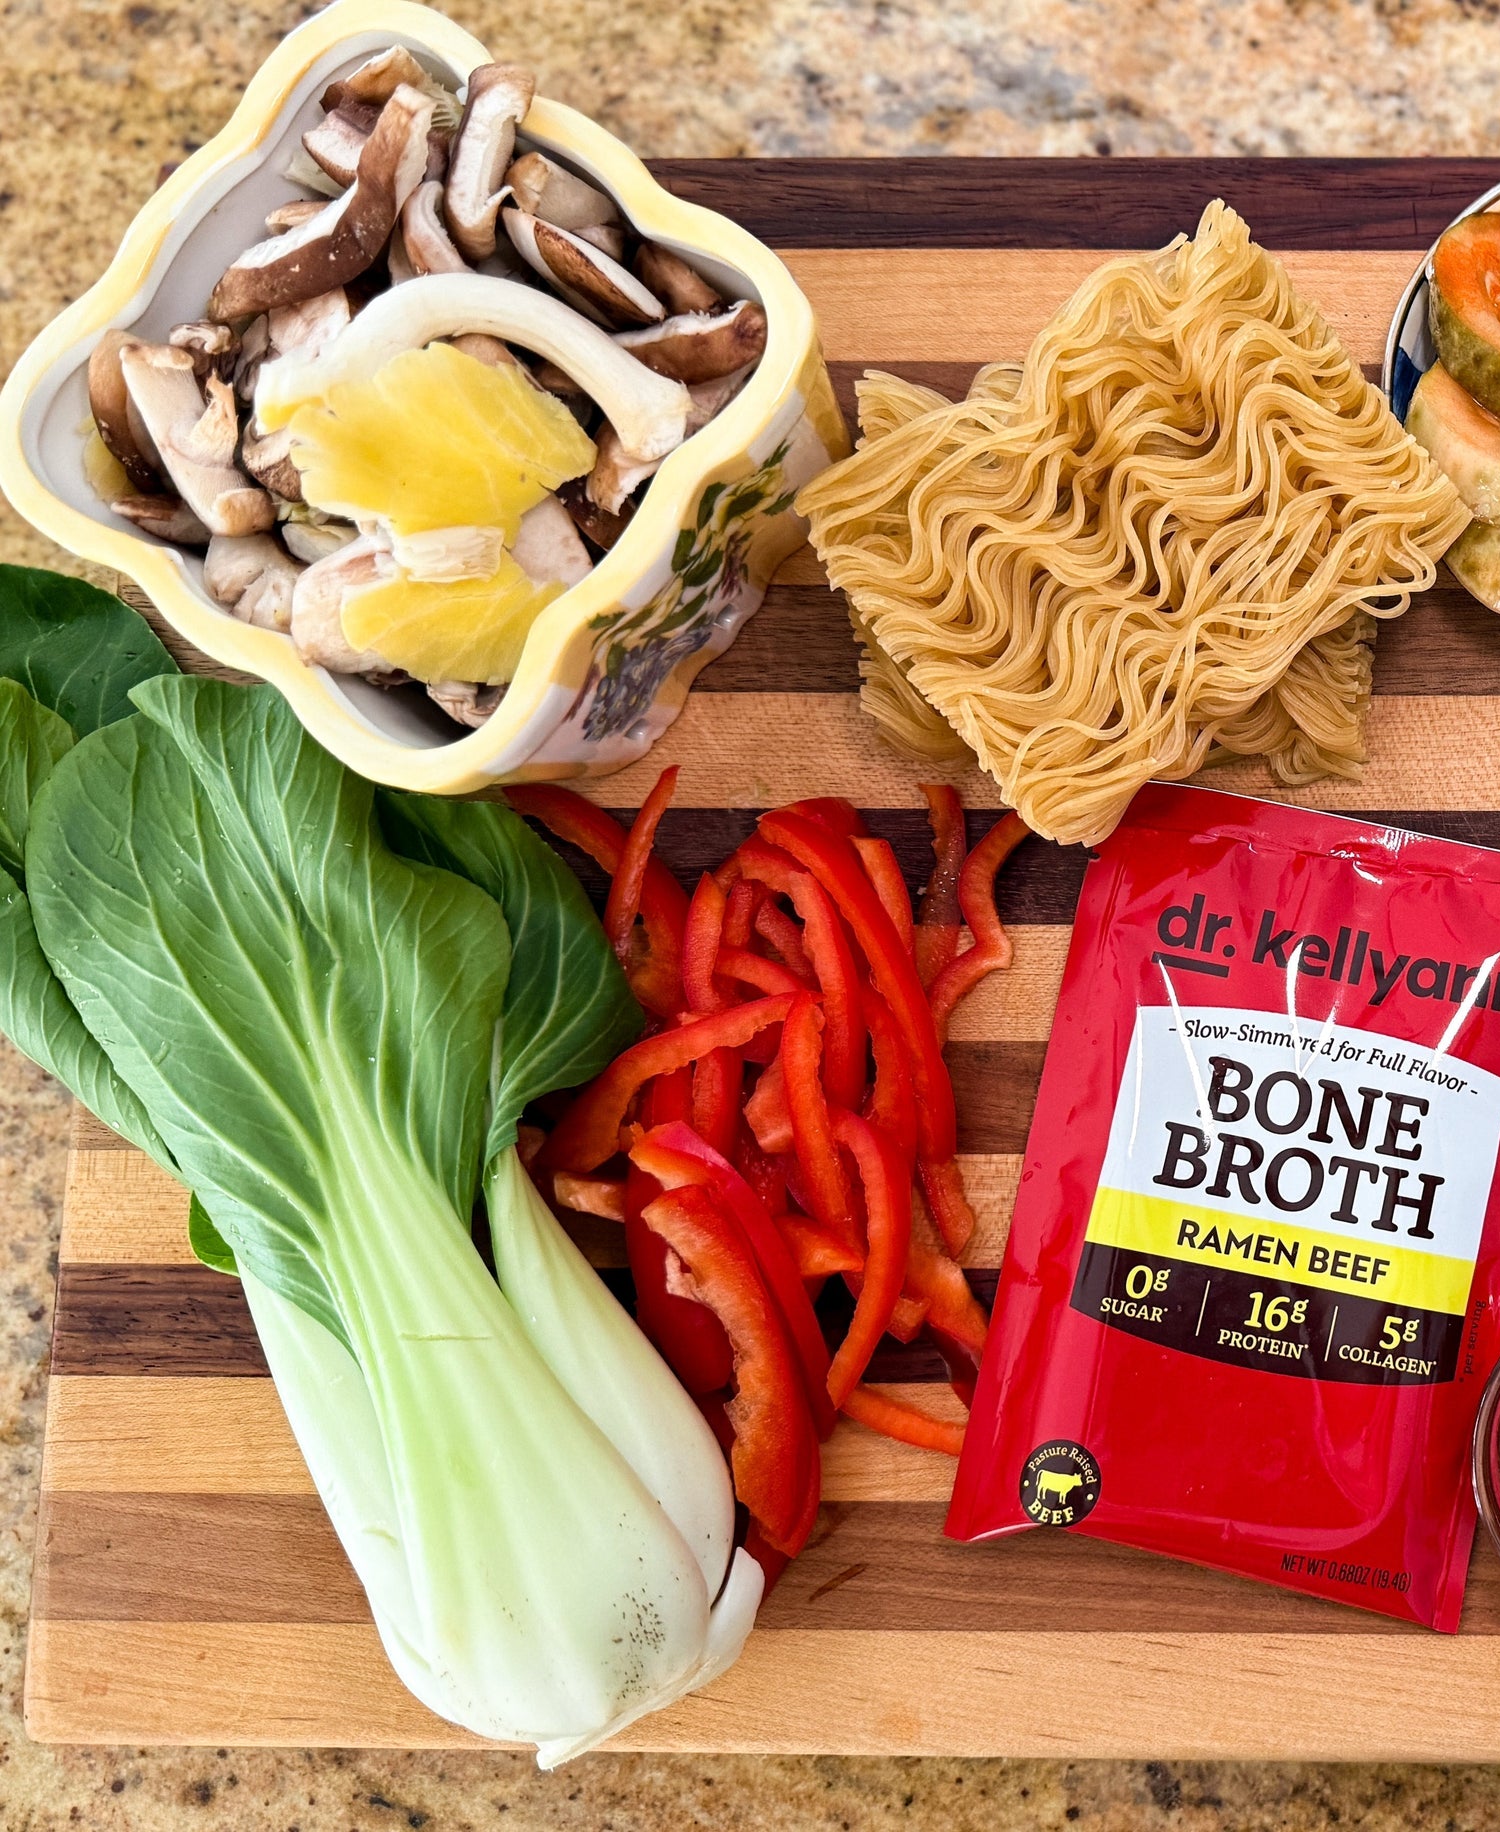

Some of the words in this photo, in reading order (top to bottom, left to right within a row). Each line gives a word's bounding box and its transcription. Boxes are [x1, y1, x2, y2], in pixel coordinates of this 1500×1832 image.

[1157, 894, 1236, 958] dr.
[1331, 1040, 1365, 1062] for
[1367, 1047, 1406, 1073] Full
[1406, 1058, 1468, 1093] Flavor
[1196, 1055, 1430, 1161] BONE
[1152, 1121, 1446, 1240] BROTH
[1176, 1218, 1300, 1268] RAMEN
[1308, 1246, 1391, 1285] BEEF
[1243, 1291, 1310, 1332] 16g
[1378, 1315, 1421, 1351] 5g
[1467, 1300, 1487, 1350] serving
[1028, 1446, 1068, 1472] Pasture
[1069, 1447, 1098, 1484] Raised
[1028, 1498, 1075, 1525] BEEF
[1281, 1553, 1305, 1574] NET
[1306, 1557, 1328, 1577] WT
